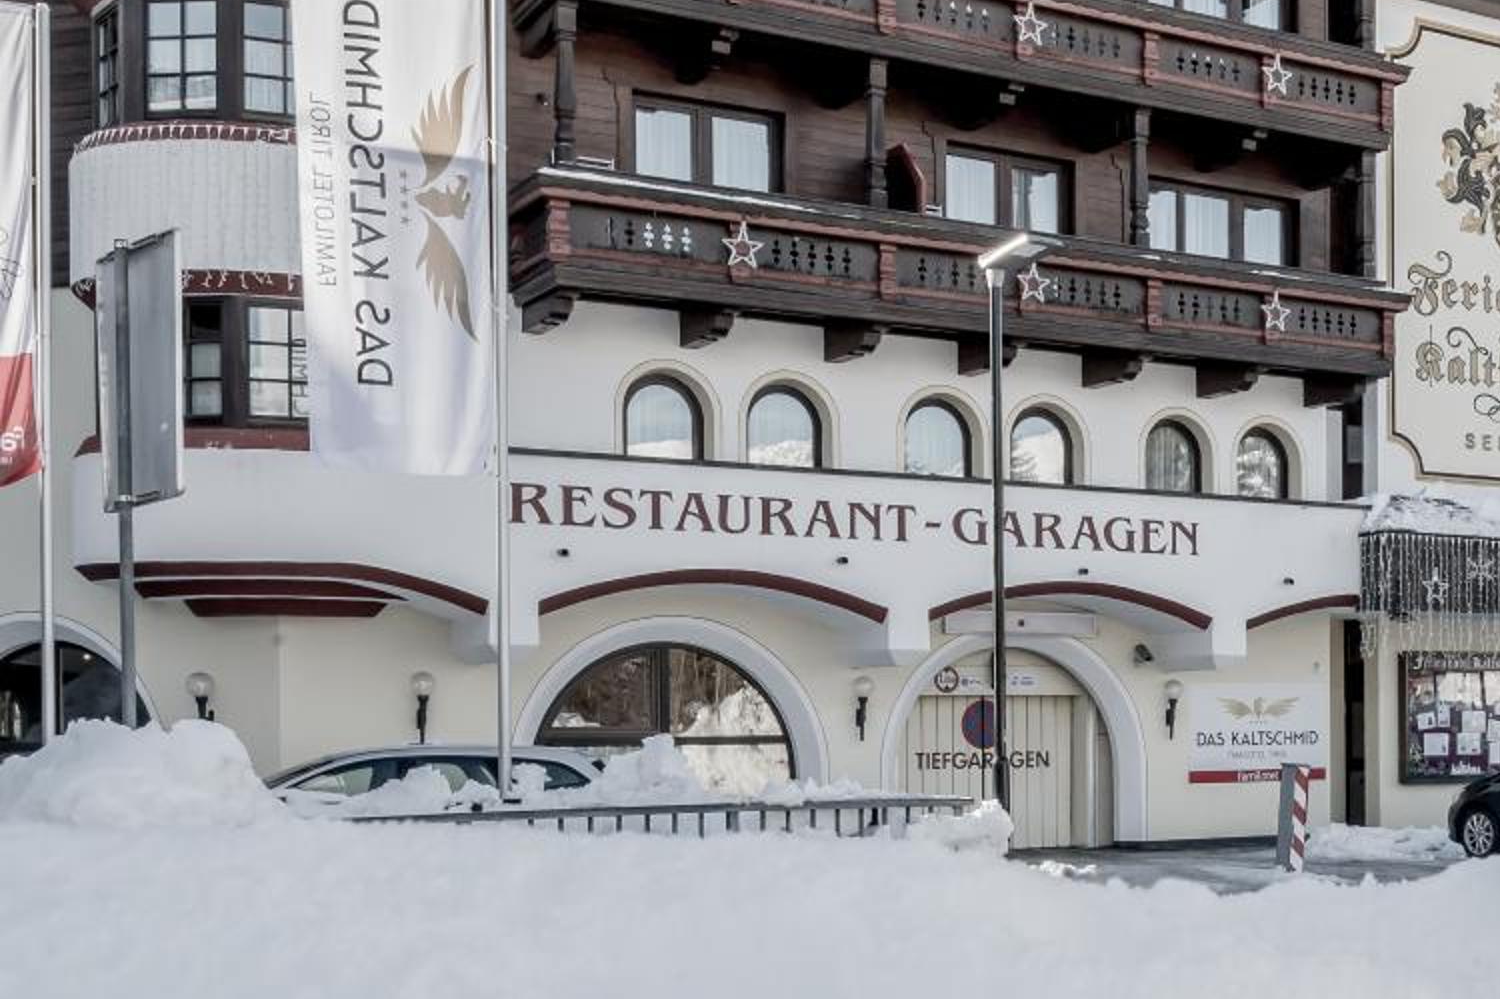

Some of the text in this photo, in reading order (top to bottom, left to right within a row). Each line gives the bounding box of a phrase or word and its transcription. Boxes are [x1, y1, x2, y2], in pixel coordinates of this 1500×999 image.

[1196, 730, 1319, 746] DAS KALTSCHMID
[915, 750, 1051, 770] TIEFGARGEN
